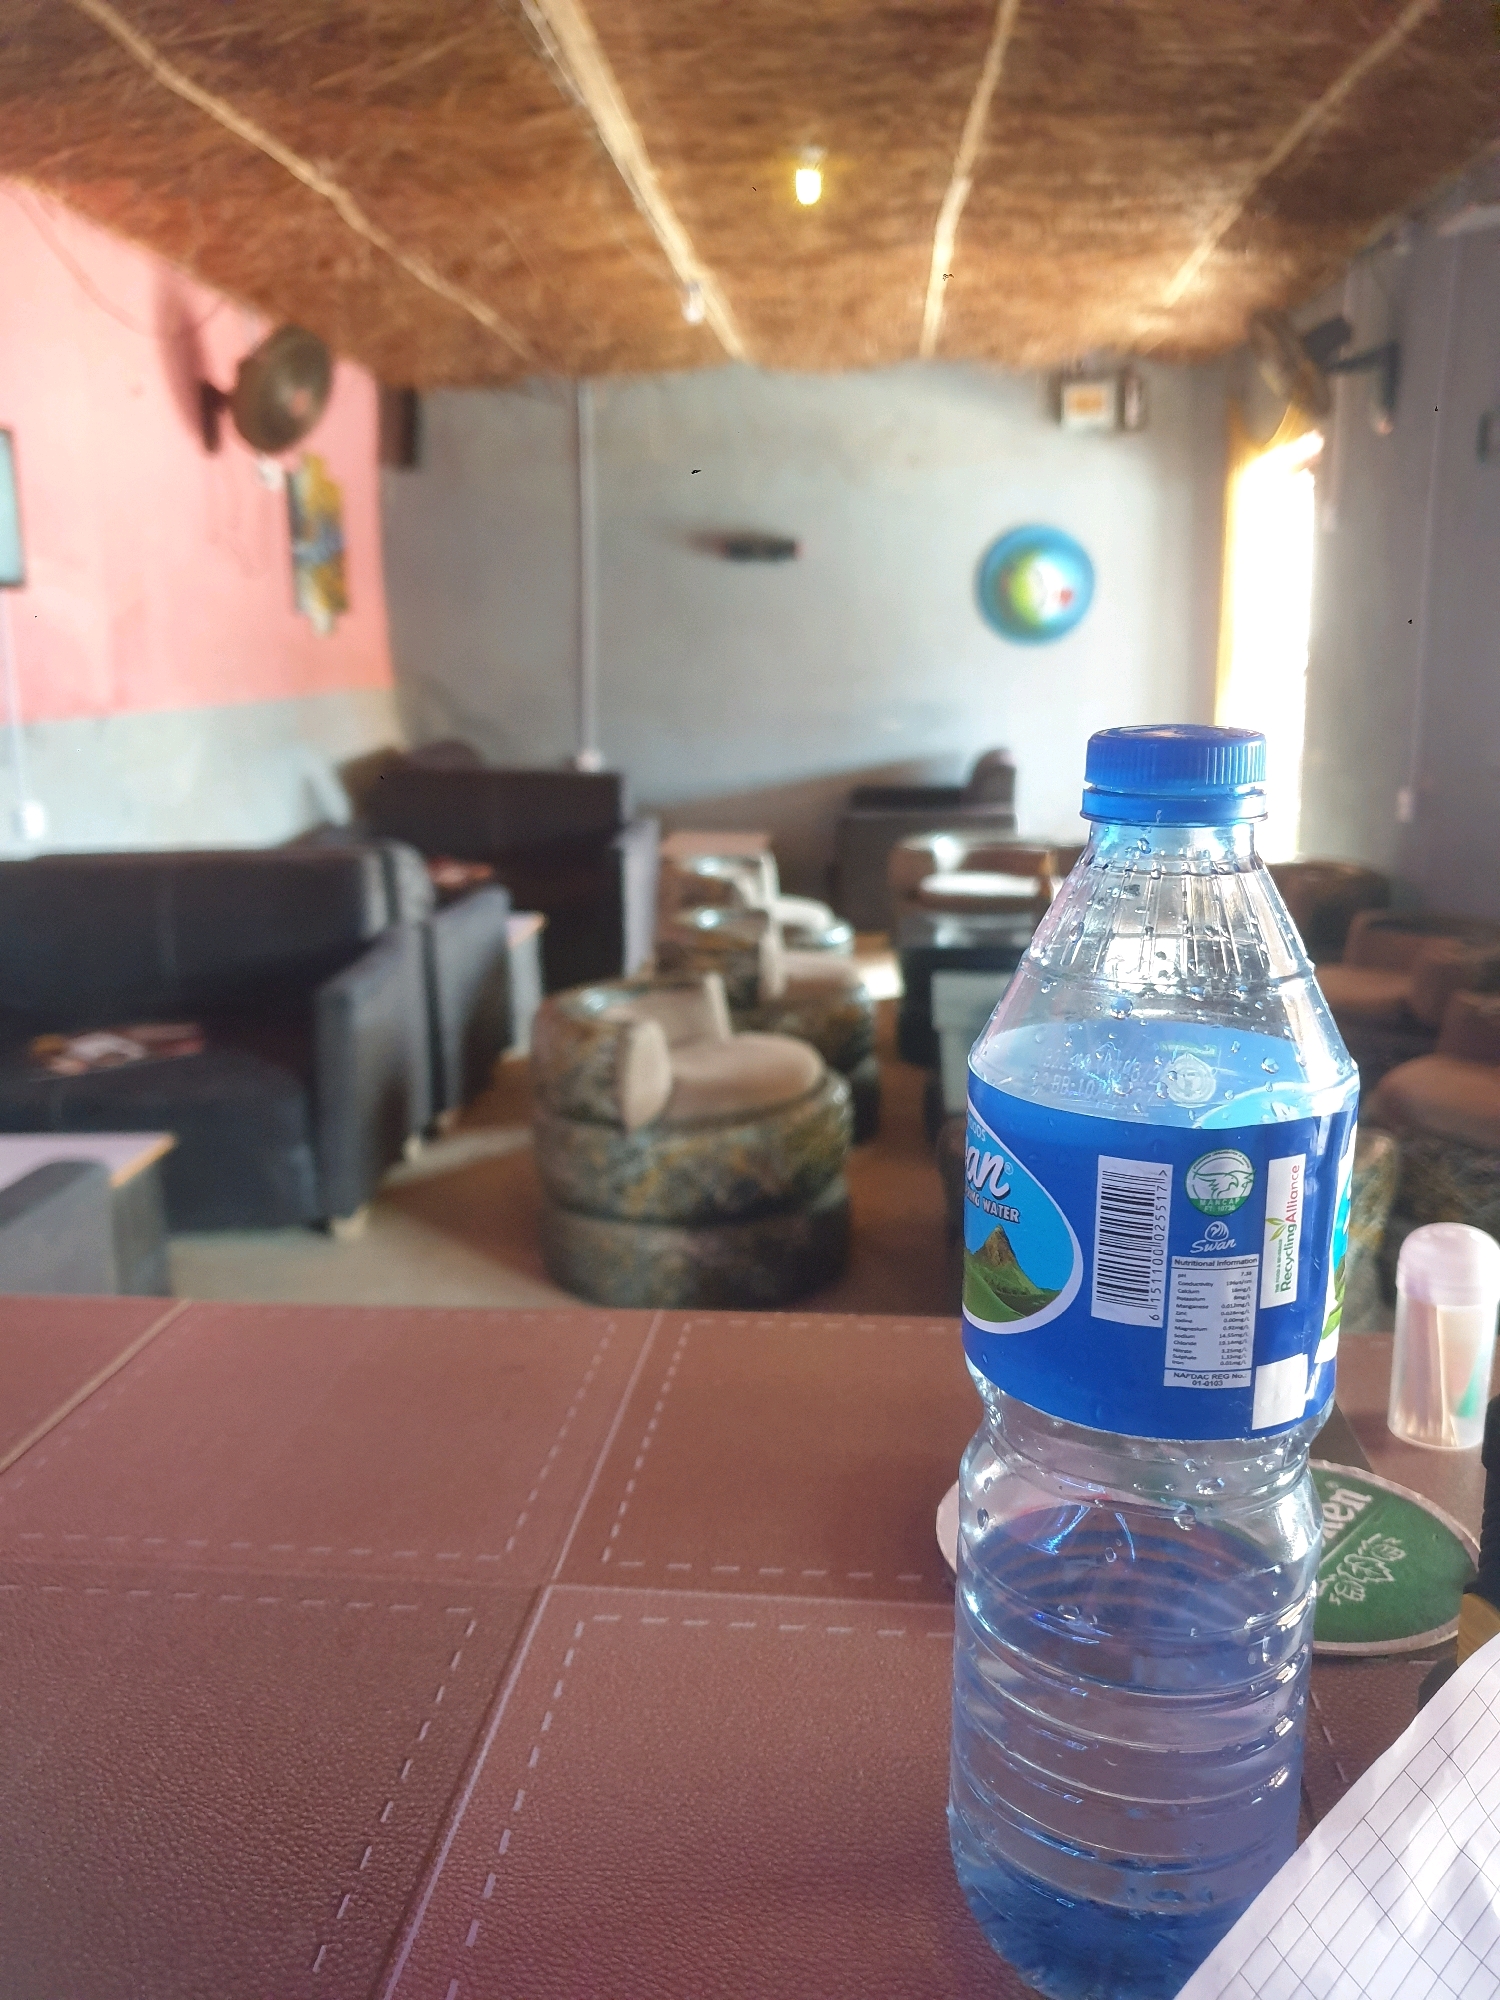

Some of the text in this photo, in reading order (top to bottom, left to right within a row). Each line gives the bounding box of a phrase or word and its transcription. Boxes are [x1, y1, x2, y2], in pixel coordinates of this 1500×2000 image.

[982, 1196, 1020, 1223] WATER
[1189, 1239, 1237, 1254] Swan
[1174, 1257, 1258, 1267] Nutritional Information
